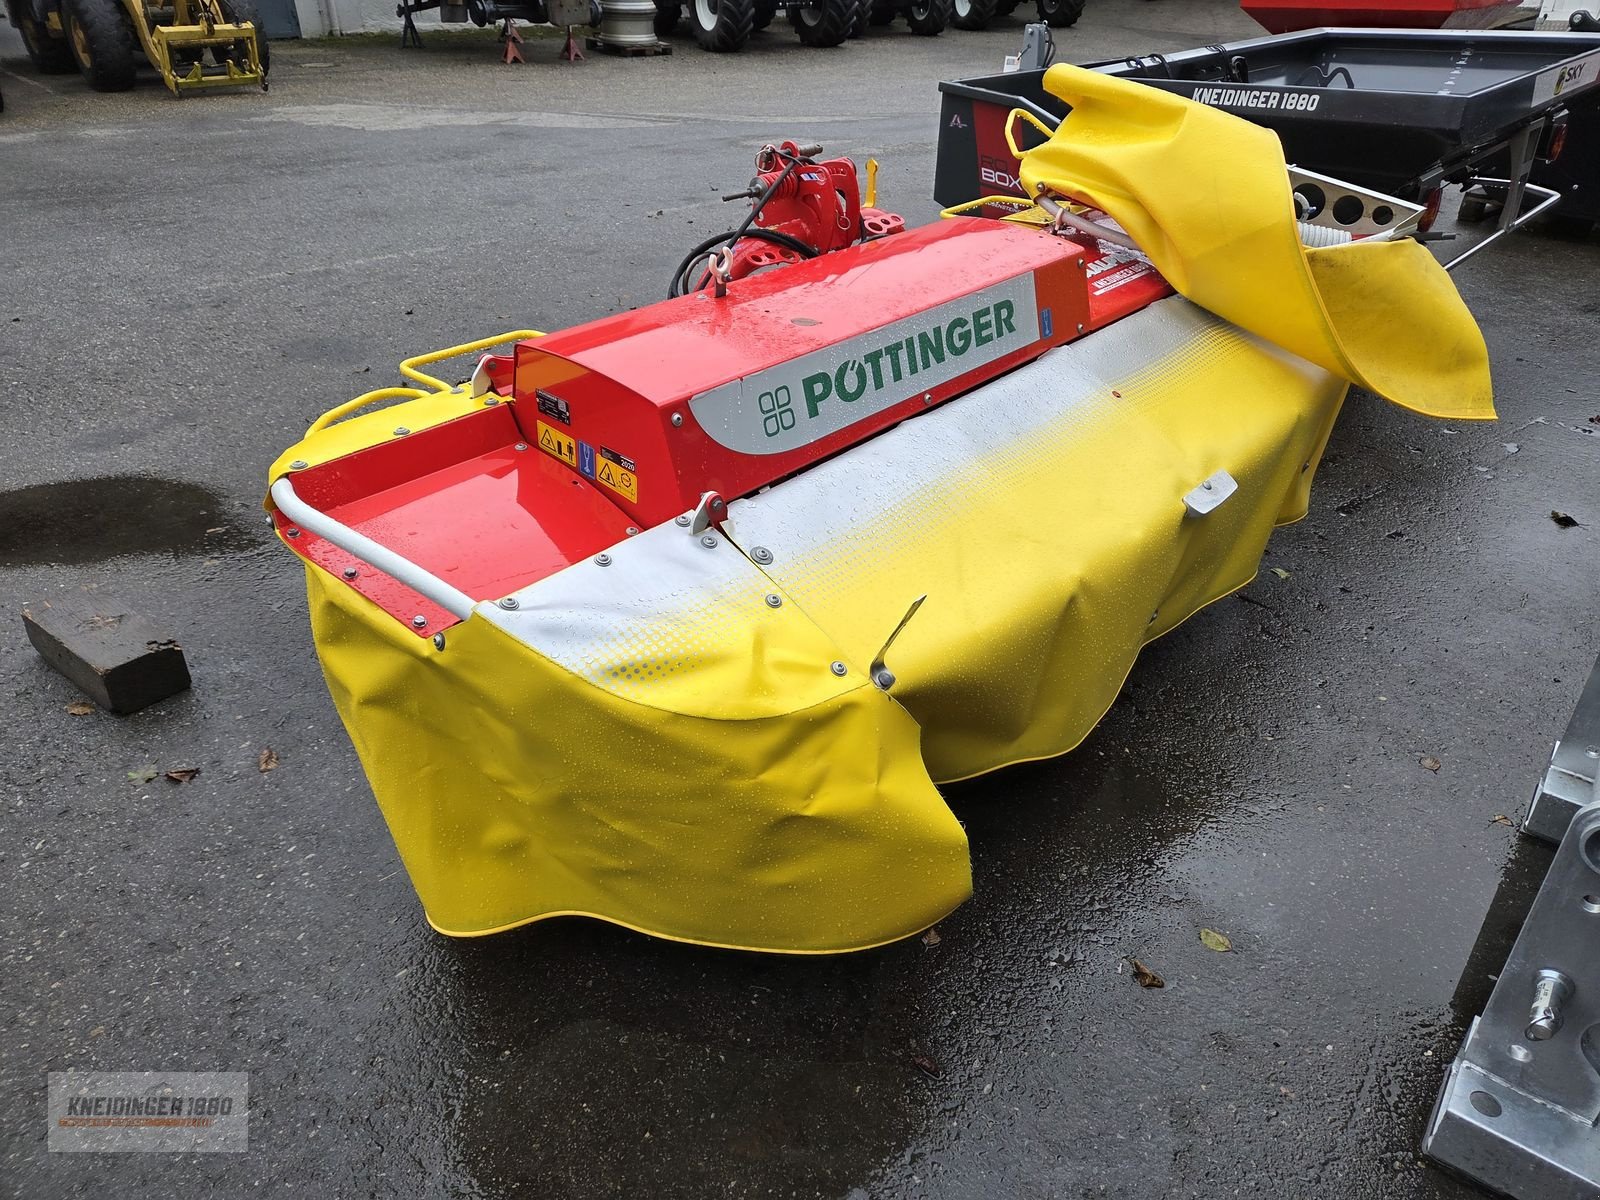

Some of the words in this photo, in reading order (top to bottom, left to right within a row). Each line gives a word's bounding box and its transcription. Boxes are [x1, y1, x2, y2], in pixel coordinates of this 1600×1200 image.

[1564, 62, 1587, 82] SKY
[1192, 87, 1280, 109] KNEIDINGER
[1280, 92, 1320, 112] 1880
[981, 167, 1022, 191] BOX
[802, 299, 1017, 419] PÖTTINGER
[620, 459, 635, 472] 2020
